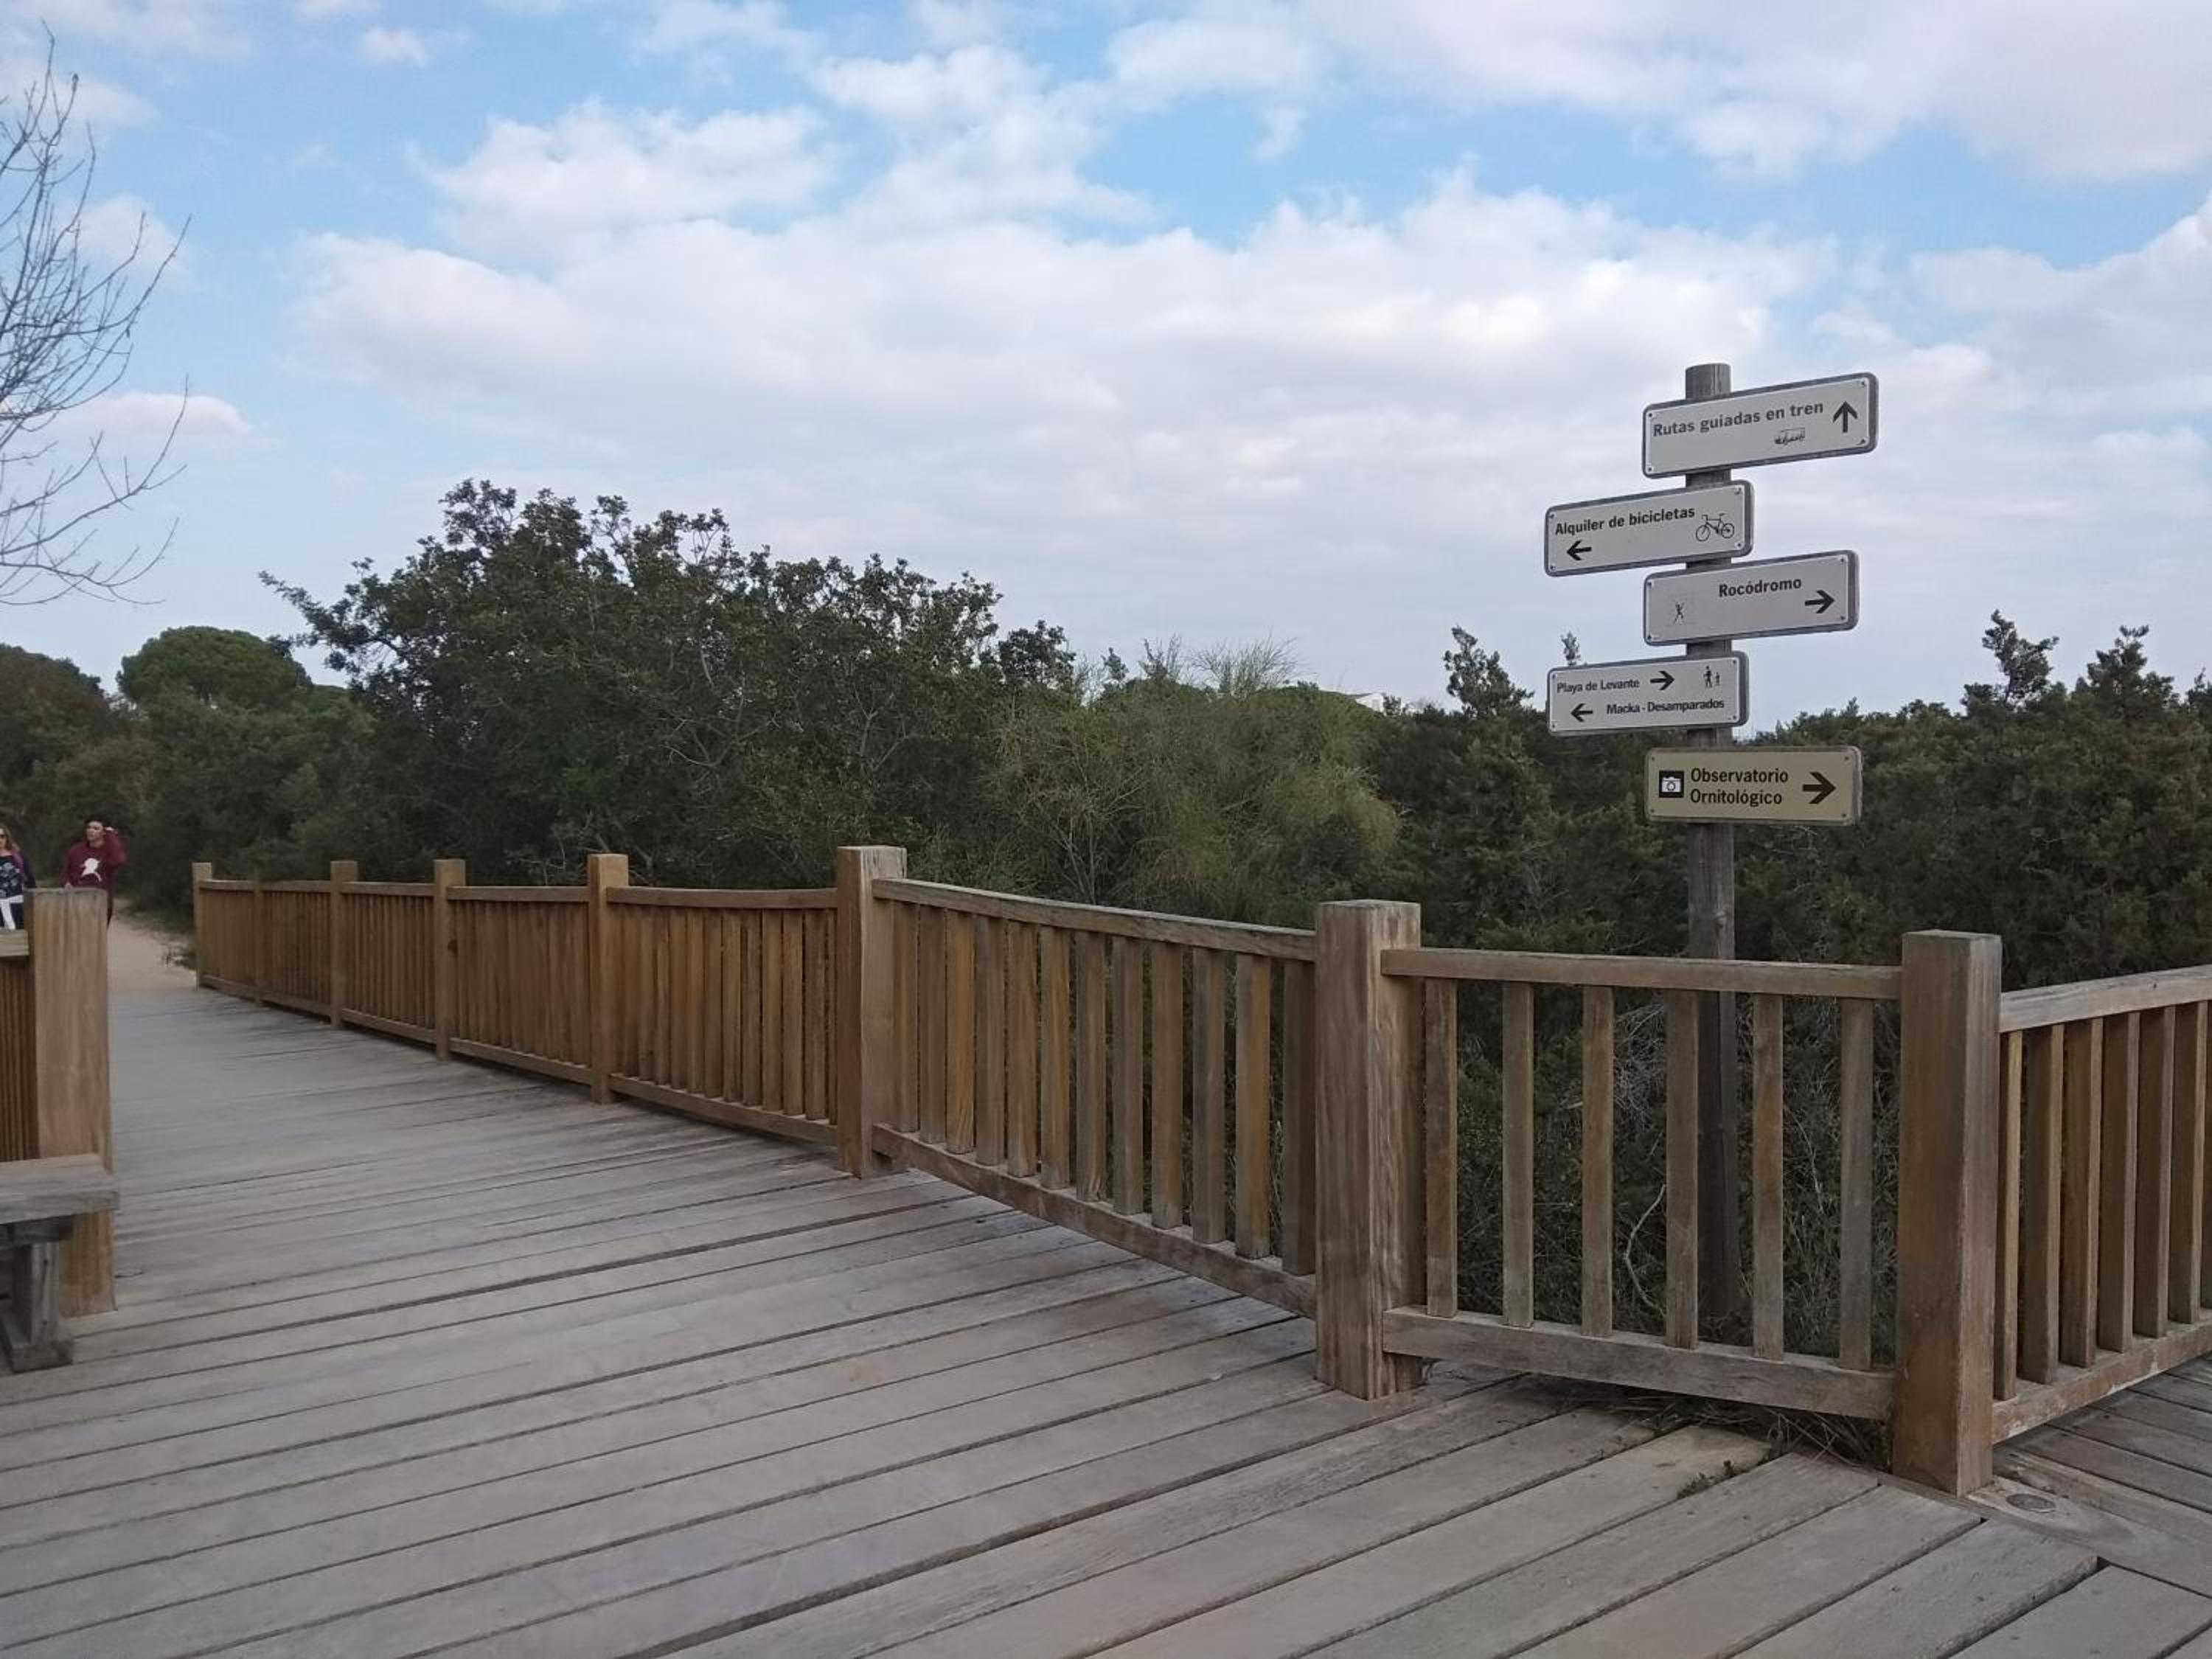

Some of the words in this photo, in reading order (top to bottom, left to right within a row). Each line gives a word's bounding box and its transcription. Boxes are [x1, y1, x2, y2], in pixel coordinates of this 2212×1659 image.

[1652, 420, 1695, 437] Rutas
[1700, 409, 1761, 432] guiadas
[1766, 406, 1785, 420] en
[1790, 402, 1824, 417] tren
[1555, 519, 1605, 536] Alquiler
[1609, 515, 1624, 529] de
[1629, 507, 1696, 526] bicicletas
[1719, 577, 1802, 597] Rocódromo
[1557, 681, 1583, 695] Playa
[1586, 681, 1598, 690] de
[1600, 678, 1641, 690] Levante
[1647, 698, 1725, 713] Desamparados
[1691, 768, 1788, 783] Observatorio
[1691, 789, 1782, 807] Ornitológico
